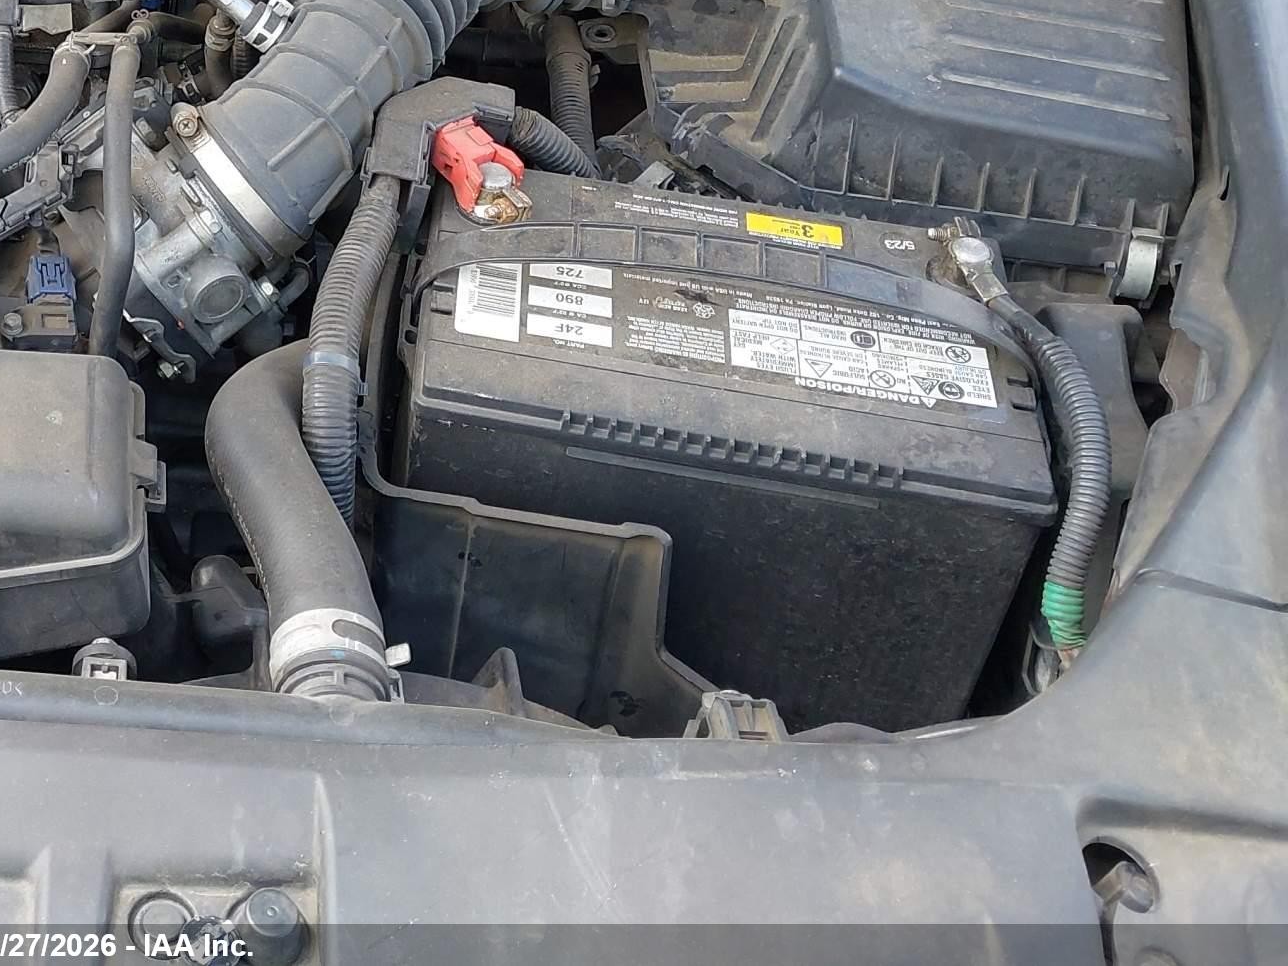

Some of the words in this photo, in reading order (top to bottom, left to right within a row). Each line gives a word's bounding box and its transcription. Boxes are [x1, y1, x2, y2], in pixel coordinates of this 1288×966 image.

[799, 224, 815, 238] 3
[882, 236, 916, 252] 5/23
[555, 265, 585, 279] 725
[554, 292, 583, 305] 890
[731, 317, 757, 326] BATTERY
[553, 321, 583, 335] 24F
[566, 340, 584, 348] PART
[731, 335, 762, 345] MEDICAL
[749, 355, 795, 367] IMMEDIATELY
[777, 354, 795, 362] WITH
[756, 361, 773, 369] EYES
[774, 365, 796, 373] FLUSH
[847, 365, 864, 373] ACID
[832, 369, 865, 380] SULFURIC
[925, 370, 949, 379] GASES
[950, 374, 988, 386] EXPLOSIVE
[793, 376, 921, 404] DANGER/POISON
[965, 391, 992, 401] SHIELD
